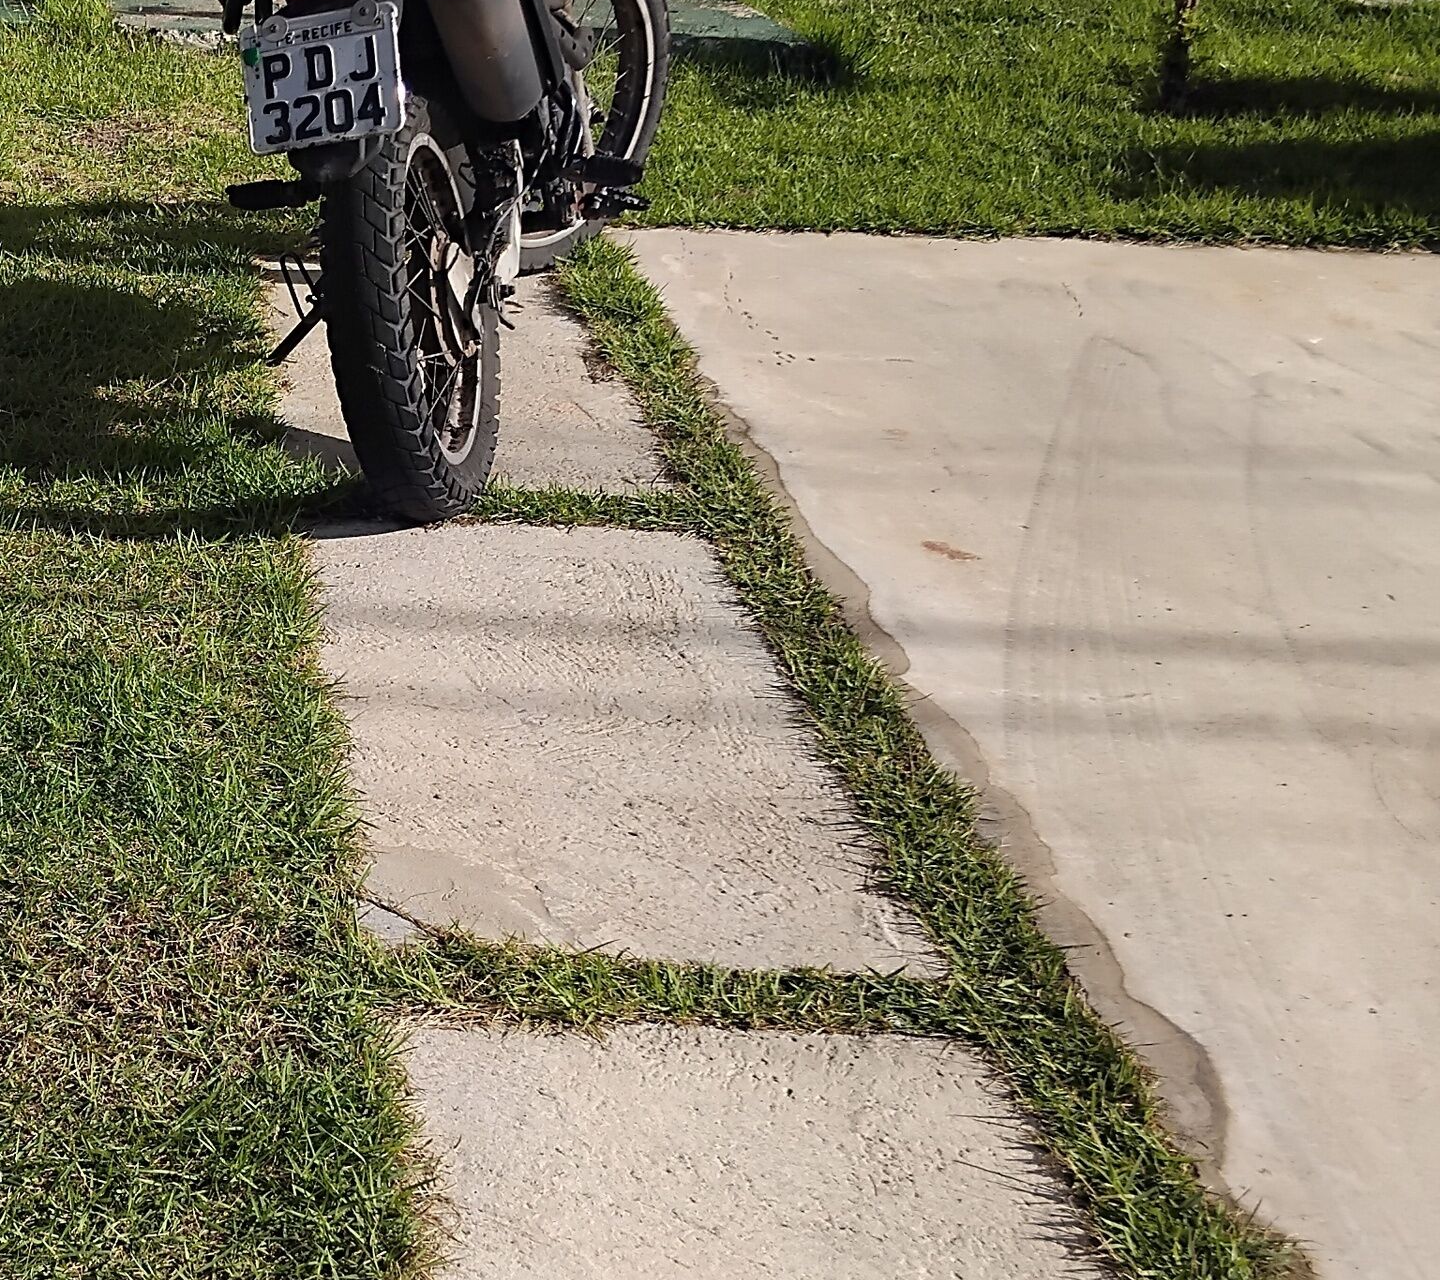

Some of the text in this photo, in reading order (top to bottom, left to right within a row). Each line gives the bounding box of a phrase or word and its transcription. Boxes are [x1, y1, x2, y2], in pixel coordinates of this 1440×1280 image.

[276, 20, 354, 47] E-RECIFE
[262, 35, 378, 100] PDJ
[262, 81, 387, 145] 3204
